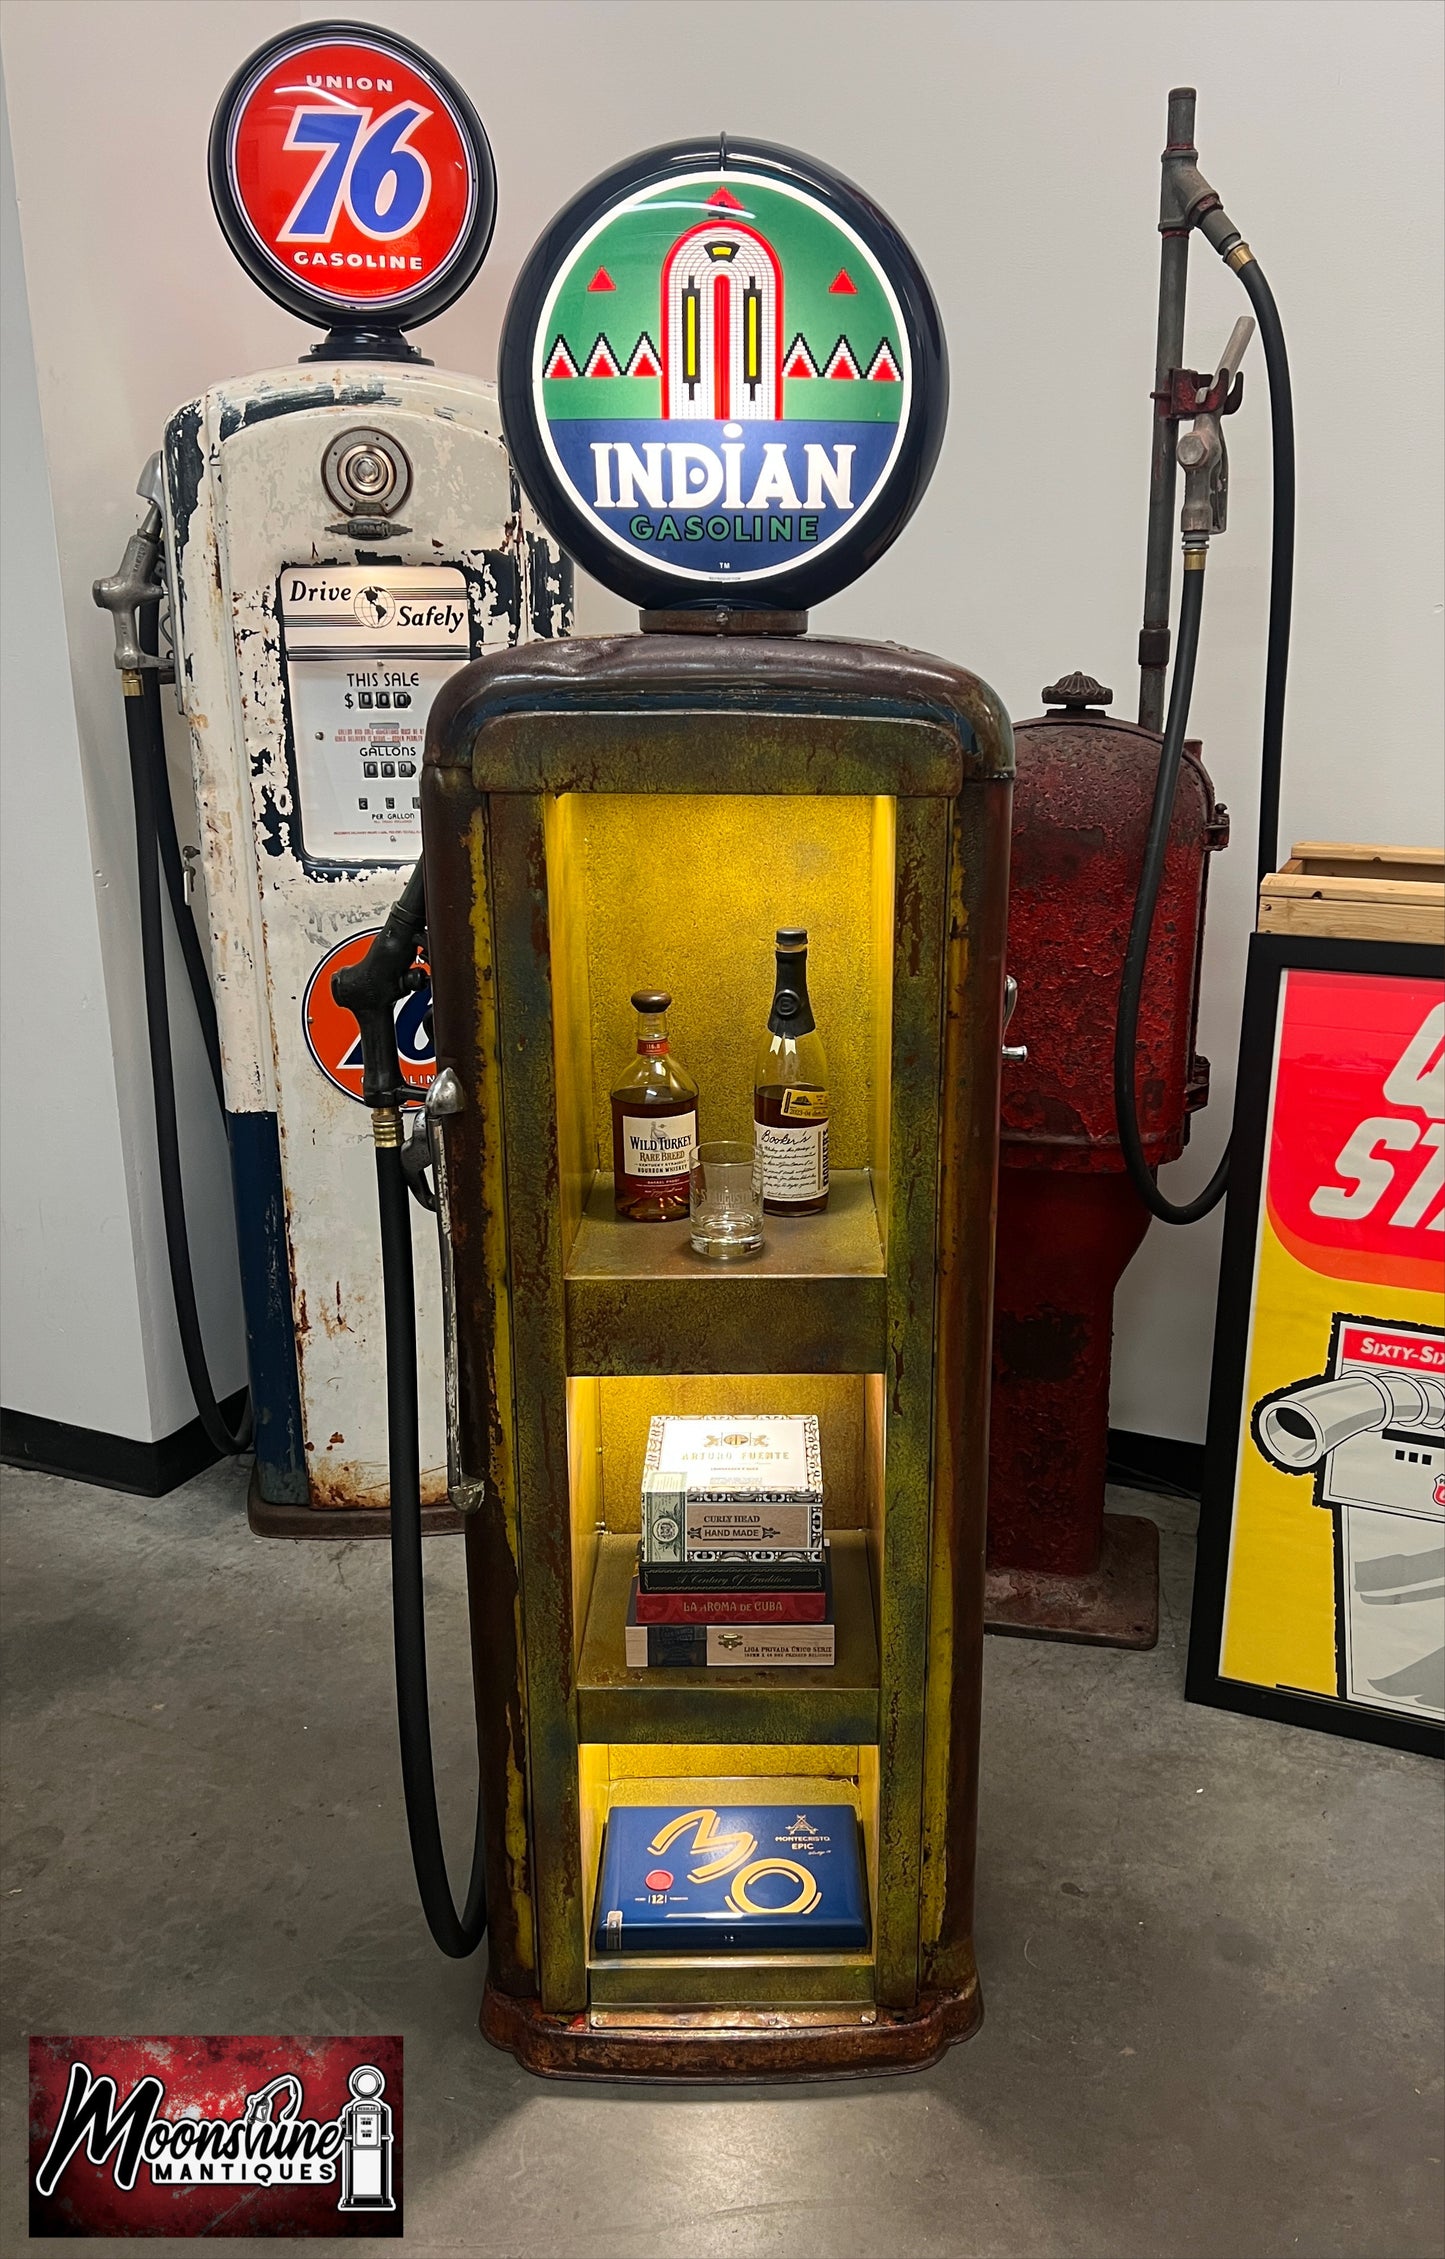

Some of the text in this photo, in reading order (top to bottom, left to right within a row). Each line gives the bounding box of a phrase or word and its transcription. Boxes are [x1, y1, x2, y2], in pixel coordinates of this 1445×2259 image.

[306, 75, 394, 92] UNION
[275, 99, 434, 243] 76
[293, 251, 423, 270] GASOLINE
[589, 422, 857, 509] INDIAN
[629, 514, 820, 542] GASOLINE
[289, 580, 465, 633] Drive Safely
[346, 672, 420, 687] THIS SALE
[360, 747, 416, 757] GALLONS
[387, 812, 415, 820] GALLON
[629, 1134, 692, 1151] WILD TURKEY
[761, 1129, 812, 1145] Booker's
[639, 1150, 685, 1162] RARE BREED
[1309, 1117, 1445, 1232] ST
[742, 1451, 790, 1460] FUENTE
[703, 1515, 760, 1523] CURLY HEAD
[704, 1529, 759, 1537] HAND MADE
[690, 1574, 729, 1586] Century
[748, 1574, 793, 1584] Tradition
[683, 1601, 698, 1612] LA
[700, 1601, 737, 1612] AROMA
[754, 1601, 783, 1612] CUBA
